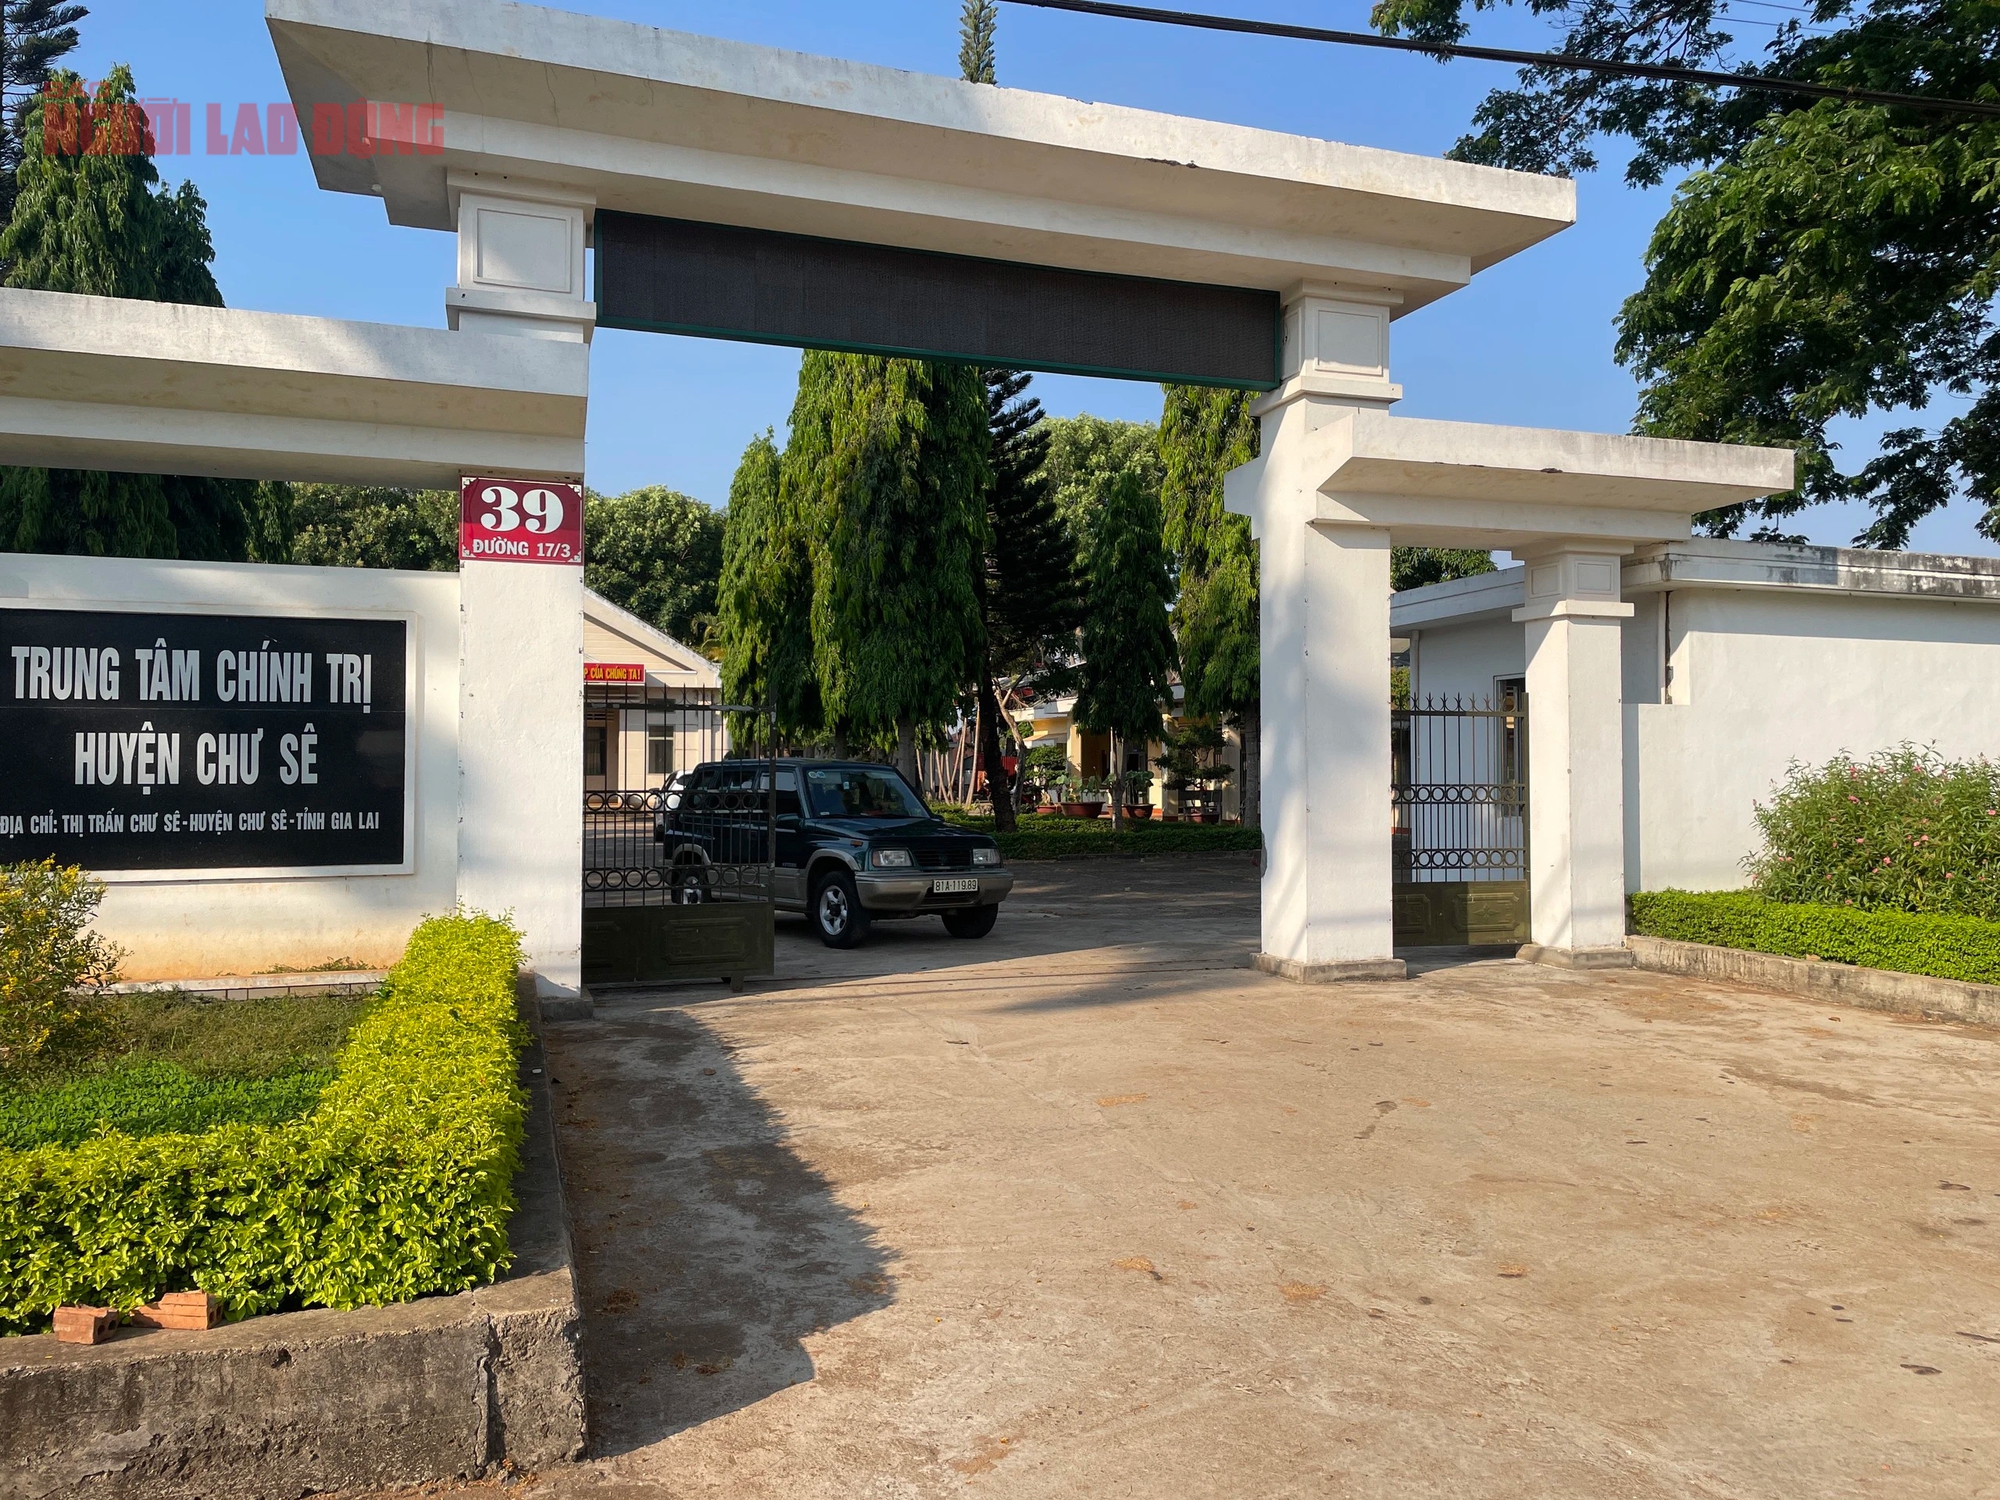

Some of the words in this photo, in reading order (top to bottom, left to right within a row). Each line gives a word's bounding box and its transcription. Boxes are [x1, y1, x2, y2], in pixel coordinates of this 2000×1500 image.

[480, 486, 564, 534] 39
[472, 536, 529, 556] ĐƯỜNG
[536, 543, 571, 558] 17/3
[11, 646, 120, 700] TRUNG
[135, 638, 200, 701] TÂM
[216, 640, 312, 703] CHÍNH
[326, 653, 372, 714] TRỊ
[590, 663, 604, 679] CỦA
[605, 665, 627, 680] CHÚNG
[74, 721, 180, 795] HUYỆN
[196, 728, 264, 786] CHƯ
[279, 723, 318, 785] SÊ
[0, 815, 24, 839] ĐỊA
[30, 809, 58, 834] CHỈ:
[62, 814, 84, 838] THỊ
[88, 807, 124, 834] TRẤN
[130, 812, 158, 833] CHƯ
[238, 811, 266, 832] CHƯ
[331, 811, 353, 830] GIA
[358, 811, 380, 830] LAI
